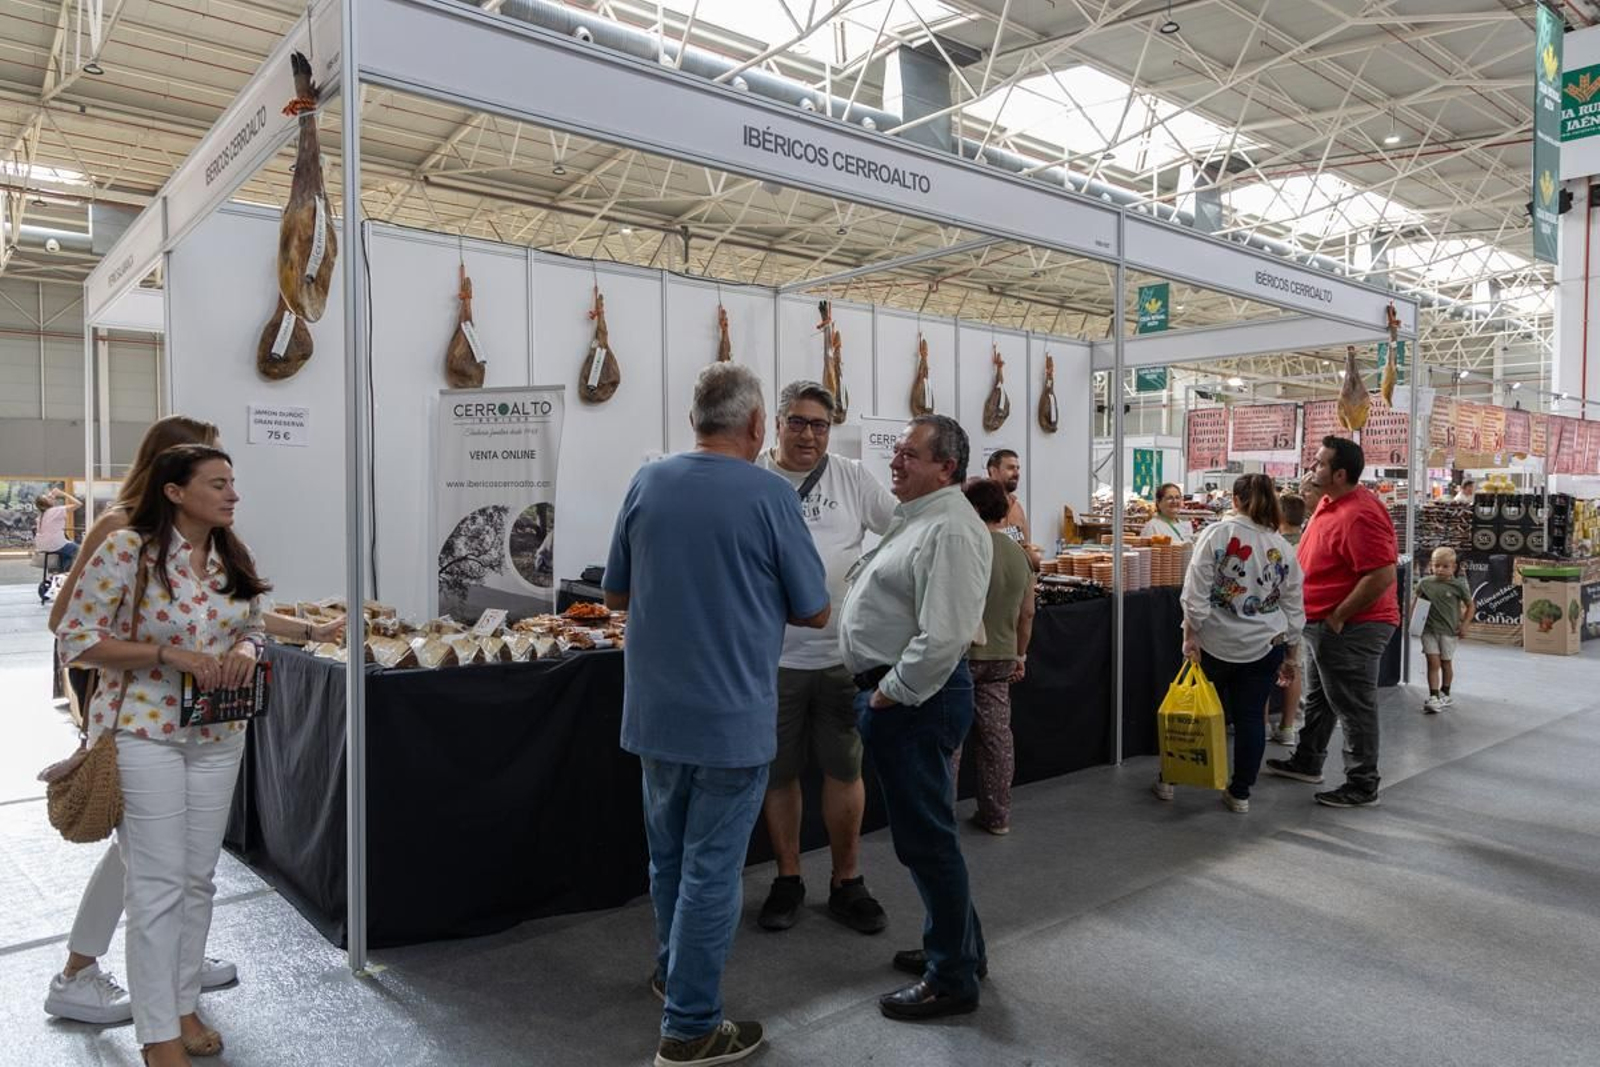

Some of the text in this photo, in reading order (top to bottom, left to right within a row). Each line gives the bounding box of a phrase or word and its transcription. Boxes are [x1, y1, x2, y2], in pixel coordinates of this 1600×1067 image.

[230, 105, 266, 161] CERROALTO
[743, 125, 931, 194] IBÉRICOS CERROALTO
[1255, 270, 1333, 304] IBÉRICOS CERROALTO
[274, 419, 305, 428] RESERVA
[267, 430, 281, 440] 75
[469, 449, 537, 460] VENTA ONLINE
